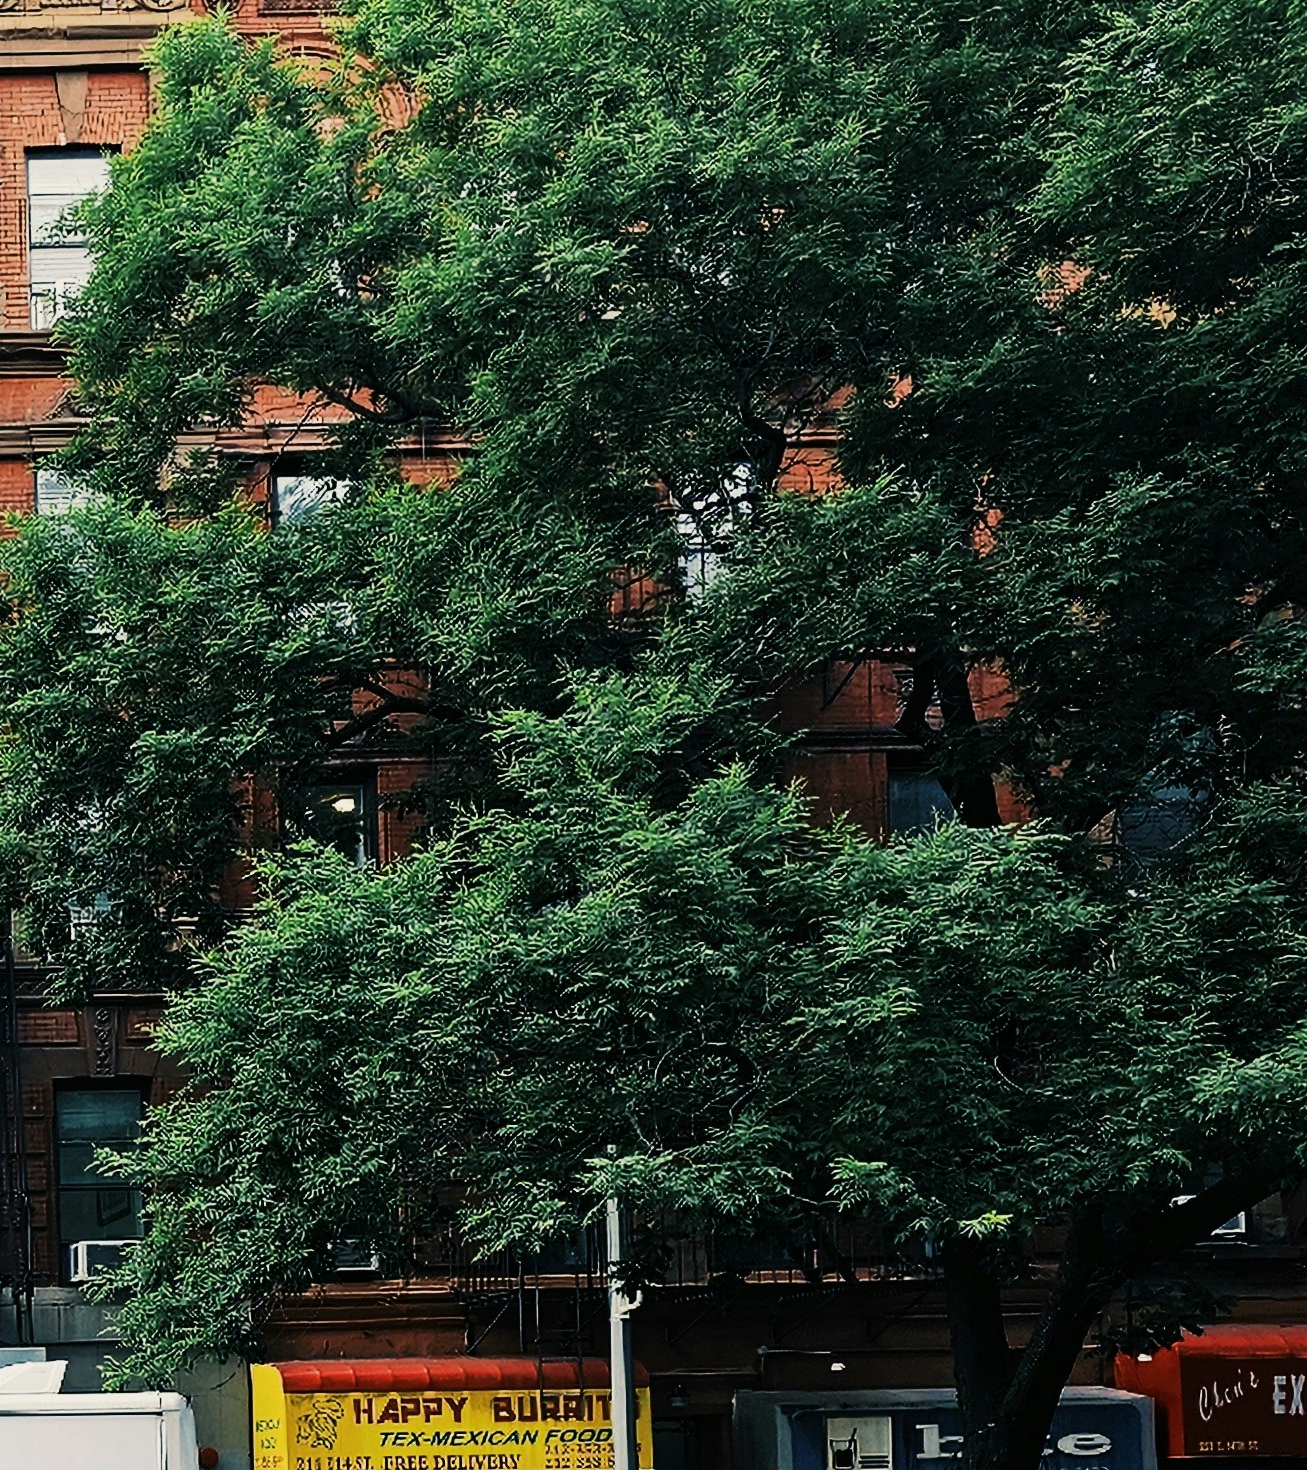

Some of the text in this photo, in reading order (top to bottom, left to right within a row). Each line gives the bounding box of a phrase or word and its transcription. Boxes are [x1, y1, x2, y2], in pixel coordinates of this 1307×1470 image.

[352, 1395, 641, 1424] HAPPY BURRIT
[379, 1427, 613, 1447] TEX-MEXICAN FOOD
[383, 1455, 429, 1470] FREE
[432, 1453, 522, 1470] DELIVERY
